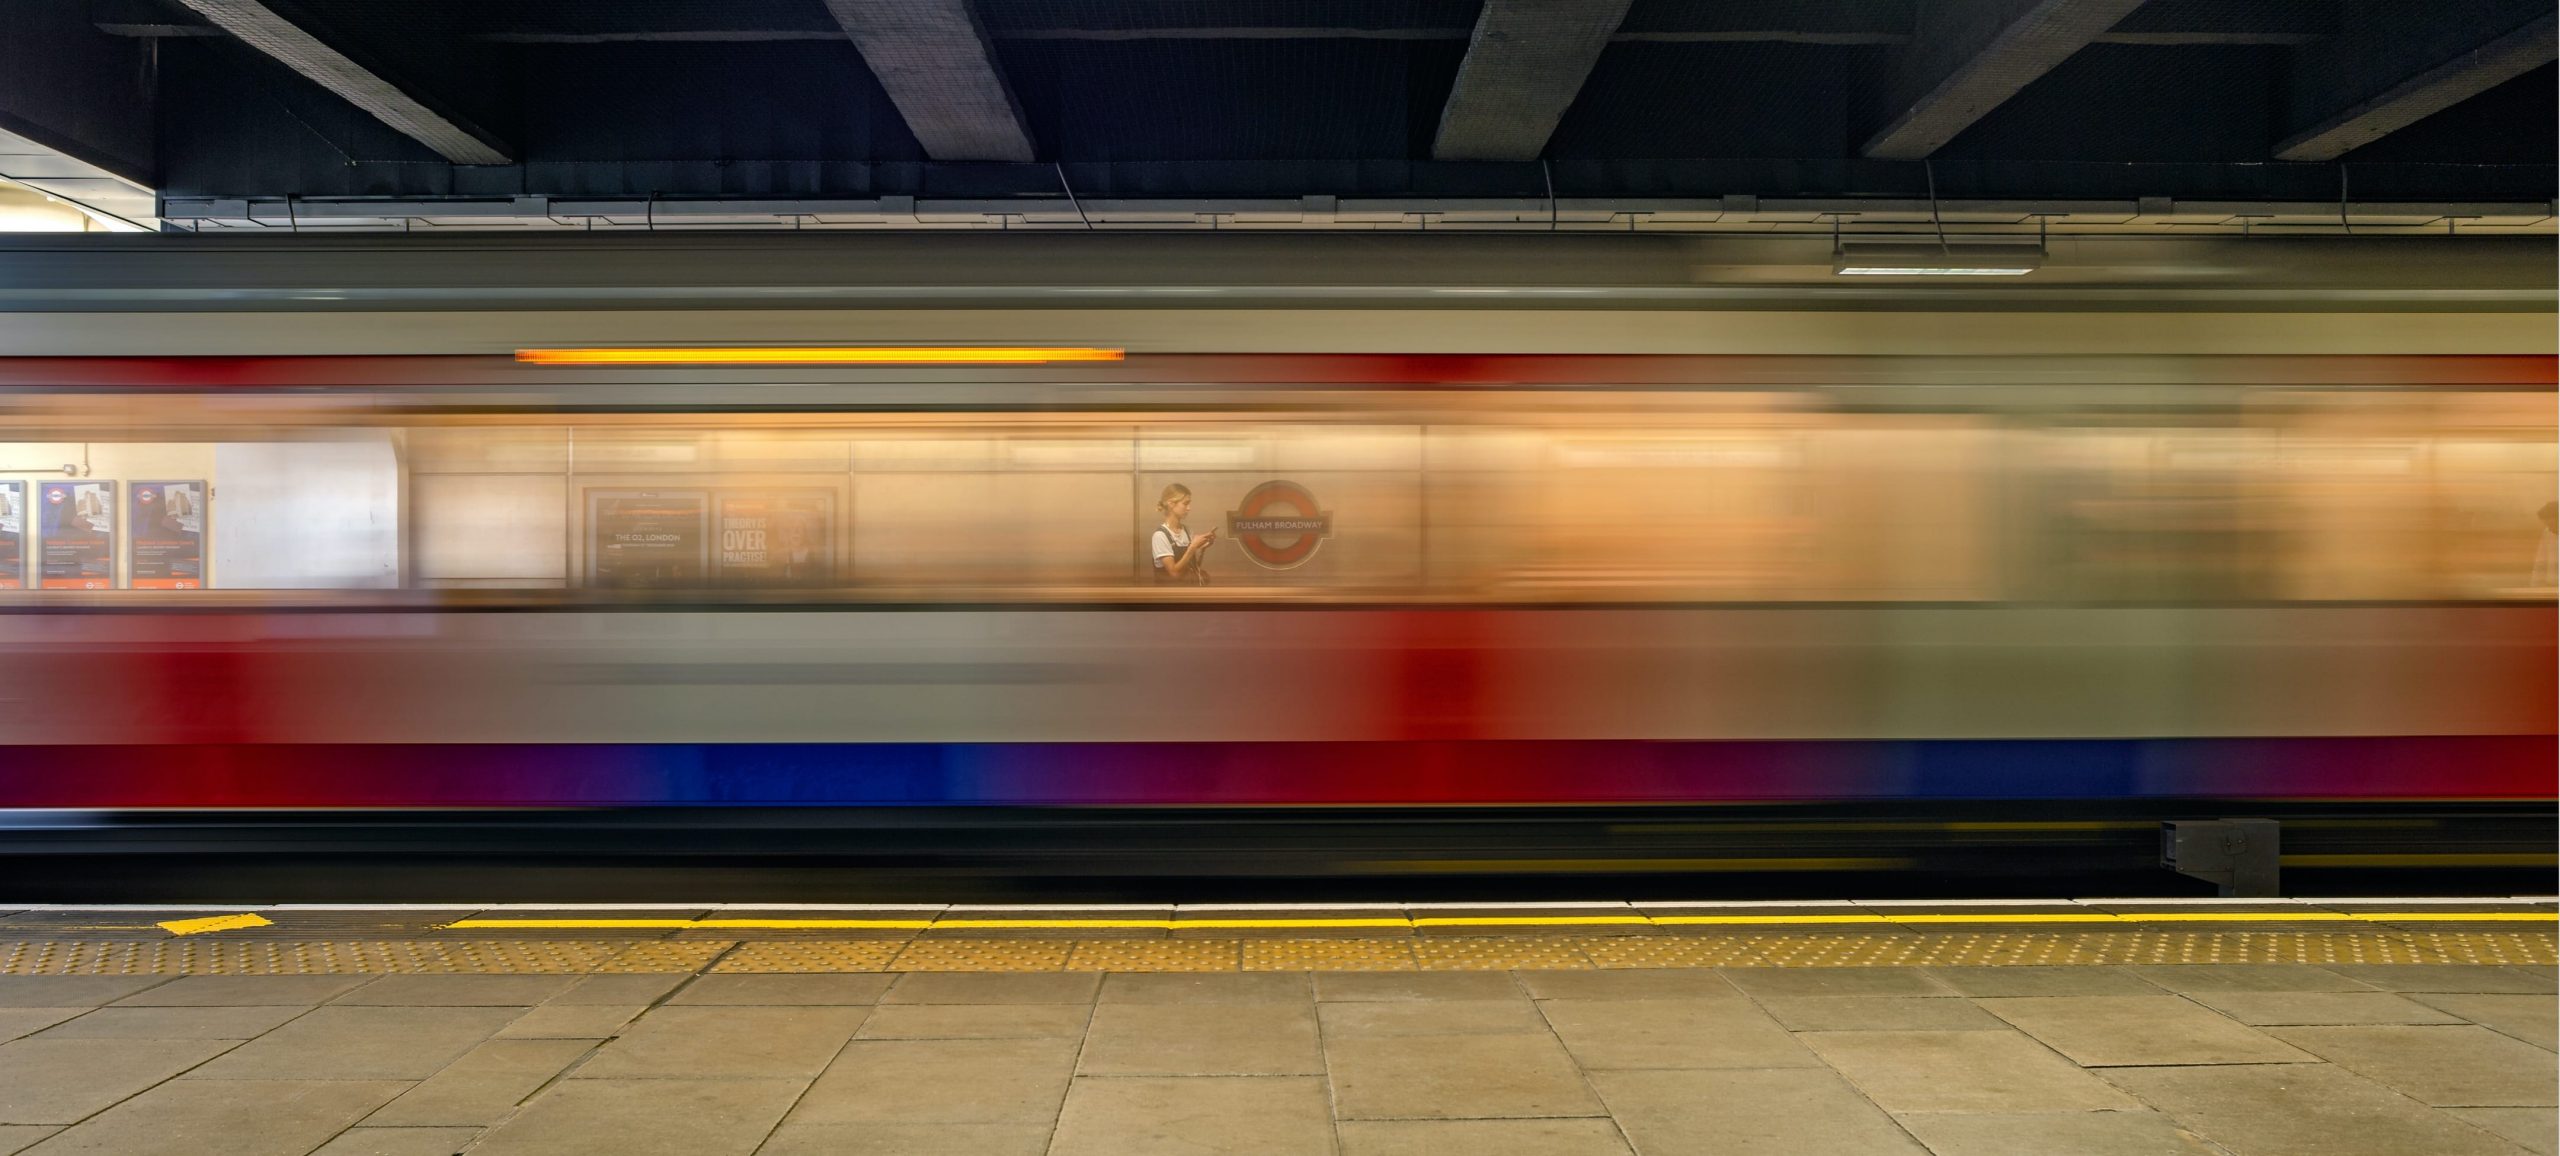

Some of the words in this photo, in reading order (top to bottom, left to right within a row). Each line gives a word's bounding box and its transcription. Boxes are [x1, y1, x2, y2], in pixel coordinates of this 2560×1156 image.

[1236, 521, 1272, 529] FULHAM
[1274, 521, 1322, 529] BROADWAY
[615, 534, 631, 542] THE
[646, 534, 681, 543] LONDON
[723, 529, 767, 551] OVER
